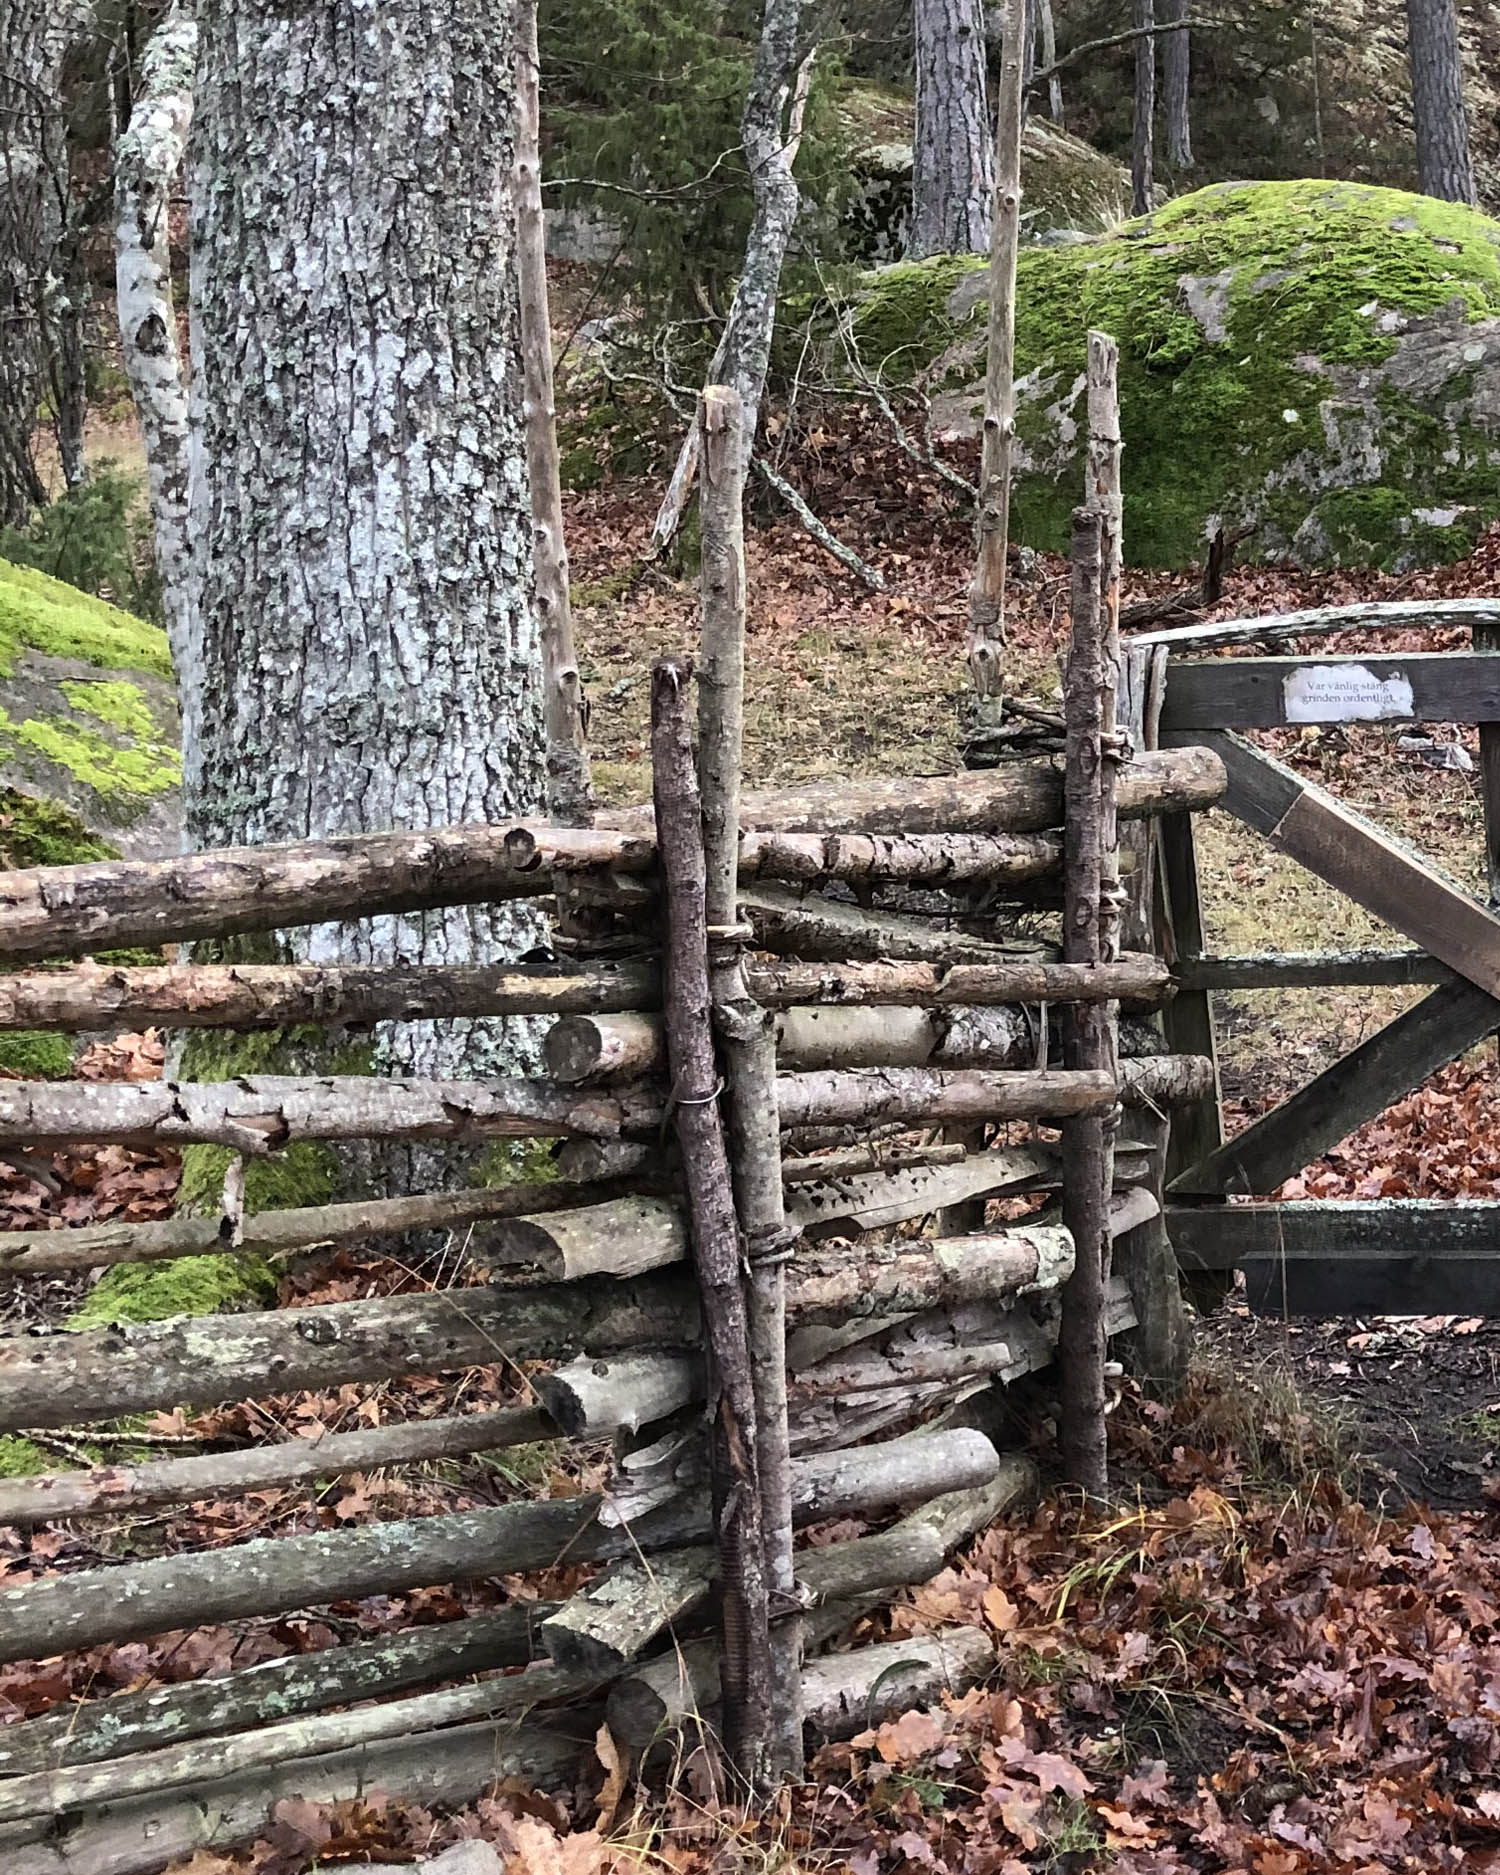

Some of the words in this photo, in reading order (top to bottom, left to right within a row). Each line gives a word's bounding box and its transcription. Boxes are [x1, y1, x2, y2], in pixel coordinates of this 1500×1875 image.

[1307, 681, 1325, 691] Var
[1328, 681, 1359, 693] vänlig
[1302, 693, 1341, 705] grinden
